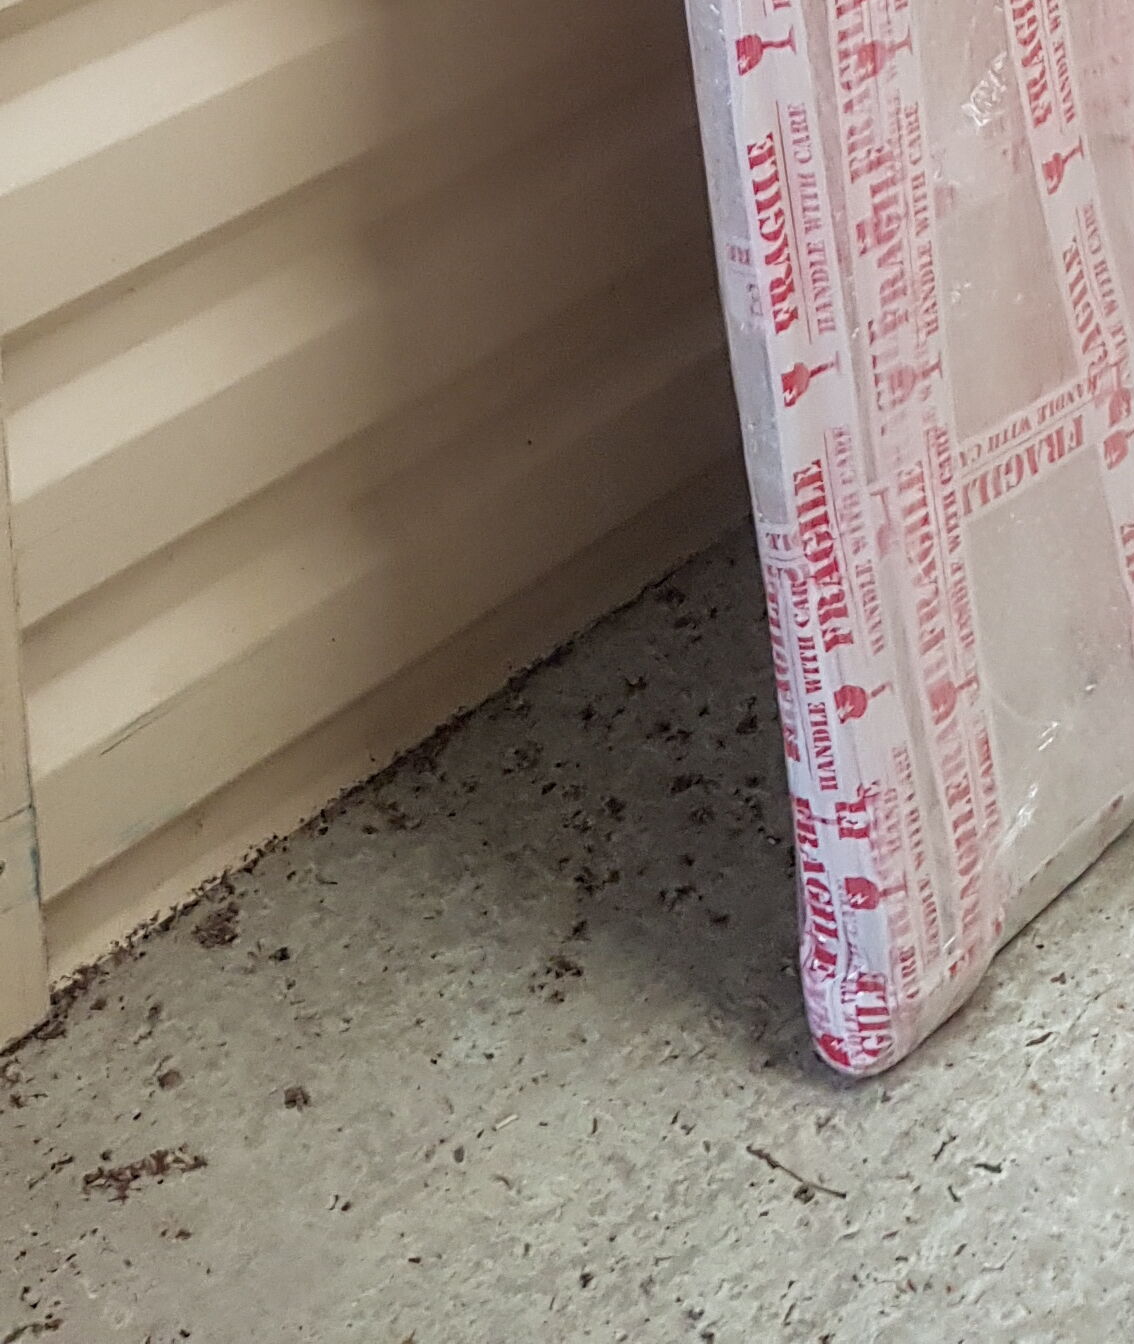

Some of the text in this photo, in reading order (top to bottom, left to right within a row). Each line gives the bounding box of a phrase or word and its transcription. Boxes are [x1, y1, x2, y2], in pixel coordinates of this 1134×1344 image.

[746, 132, 799, 334] FRAGILE
[788, 103, 836, 335] HANDLE WITH CARE
[911, 171, 930, 236] WITH
[917, 241, 939, 338] HANDLE
[988, 420, 1032, 449] WITH
[793, 458, 854, 652] FRAGILE
[797, 636, 838, 791] HANDLE WITH
